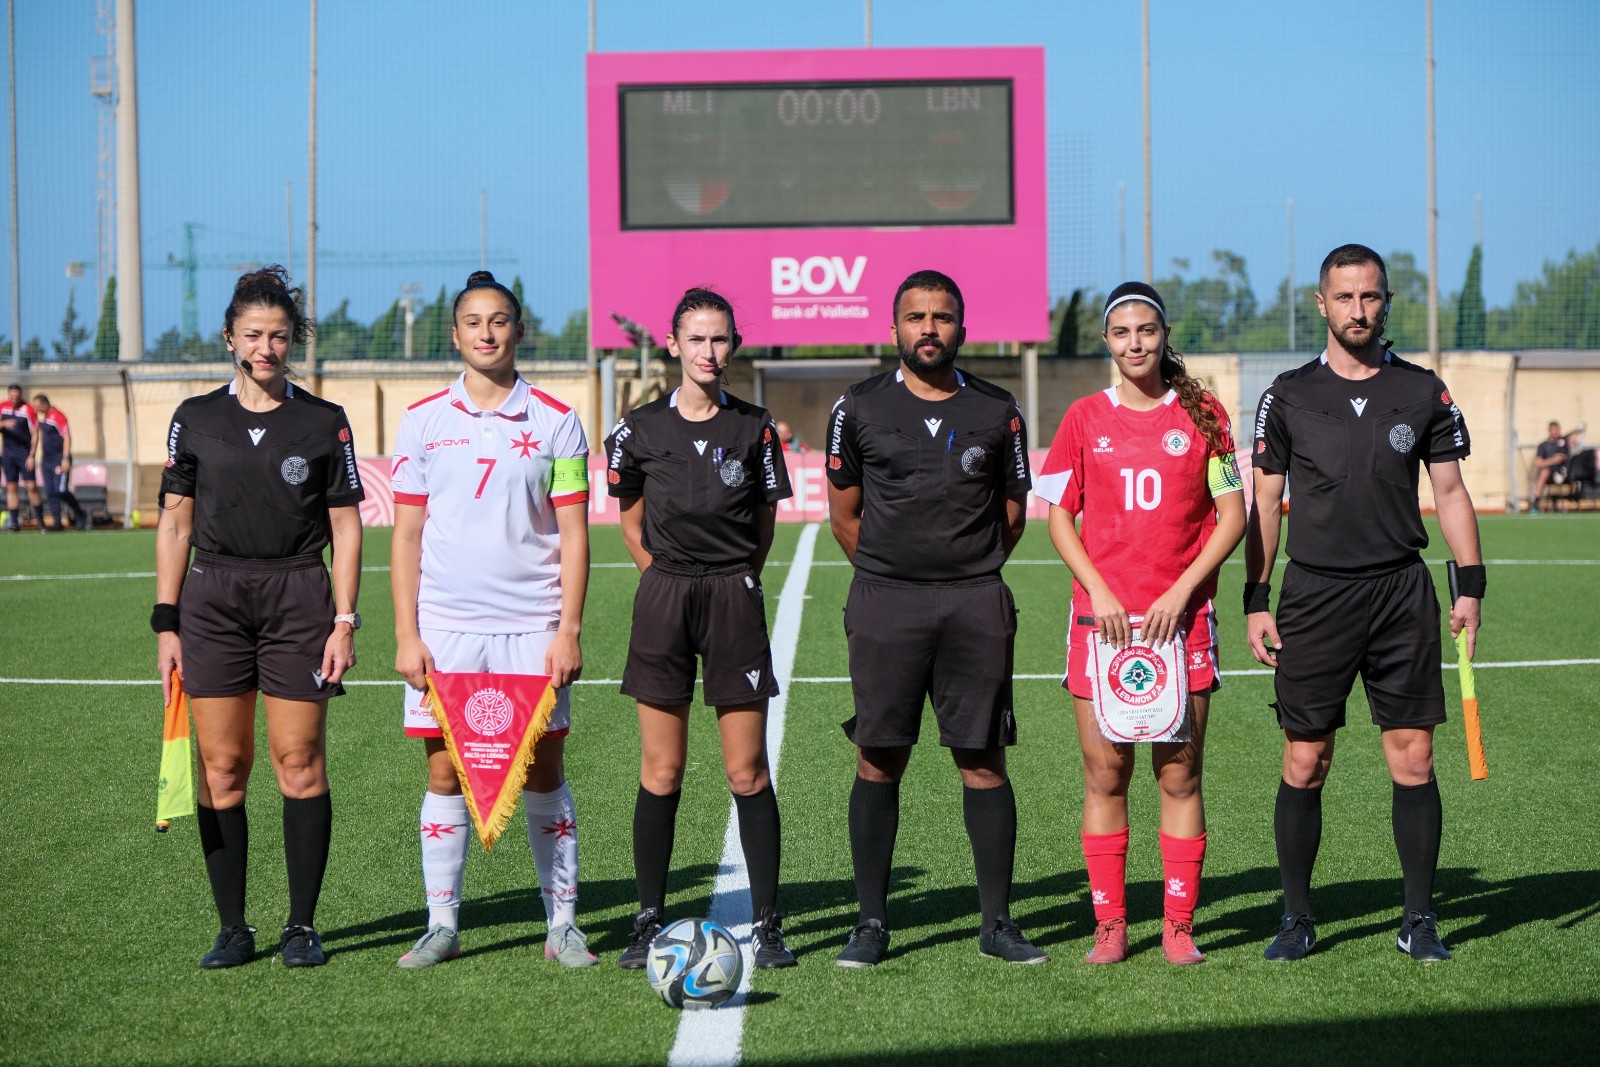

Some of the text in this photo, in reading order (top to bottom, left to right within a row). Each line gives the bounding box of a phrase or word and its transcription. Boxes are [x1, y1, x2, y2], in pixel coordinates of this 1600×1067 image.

[777, 89, 882, 125] 00:00
[926, 87, 982, 112] LBN
[771, 256, 868, 295] BOV
[772, 304, 870, 319] Bank of Valletta
[425, 438, 470, 451] GIVOVA
[474, 457, 497, 500] 7
[1120, 468, 1162, 511] 10
[473, 687, 506, 700] MALTA FA
[1115, 687, 1153, 704] LEBANON
[486, 752, 510, 760] LEBANON
